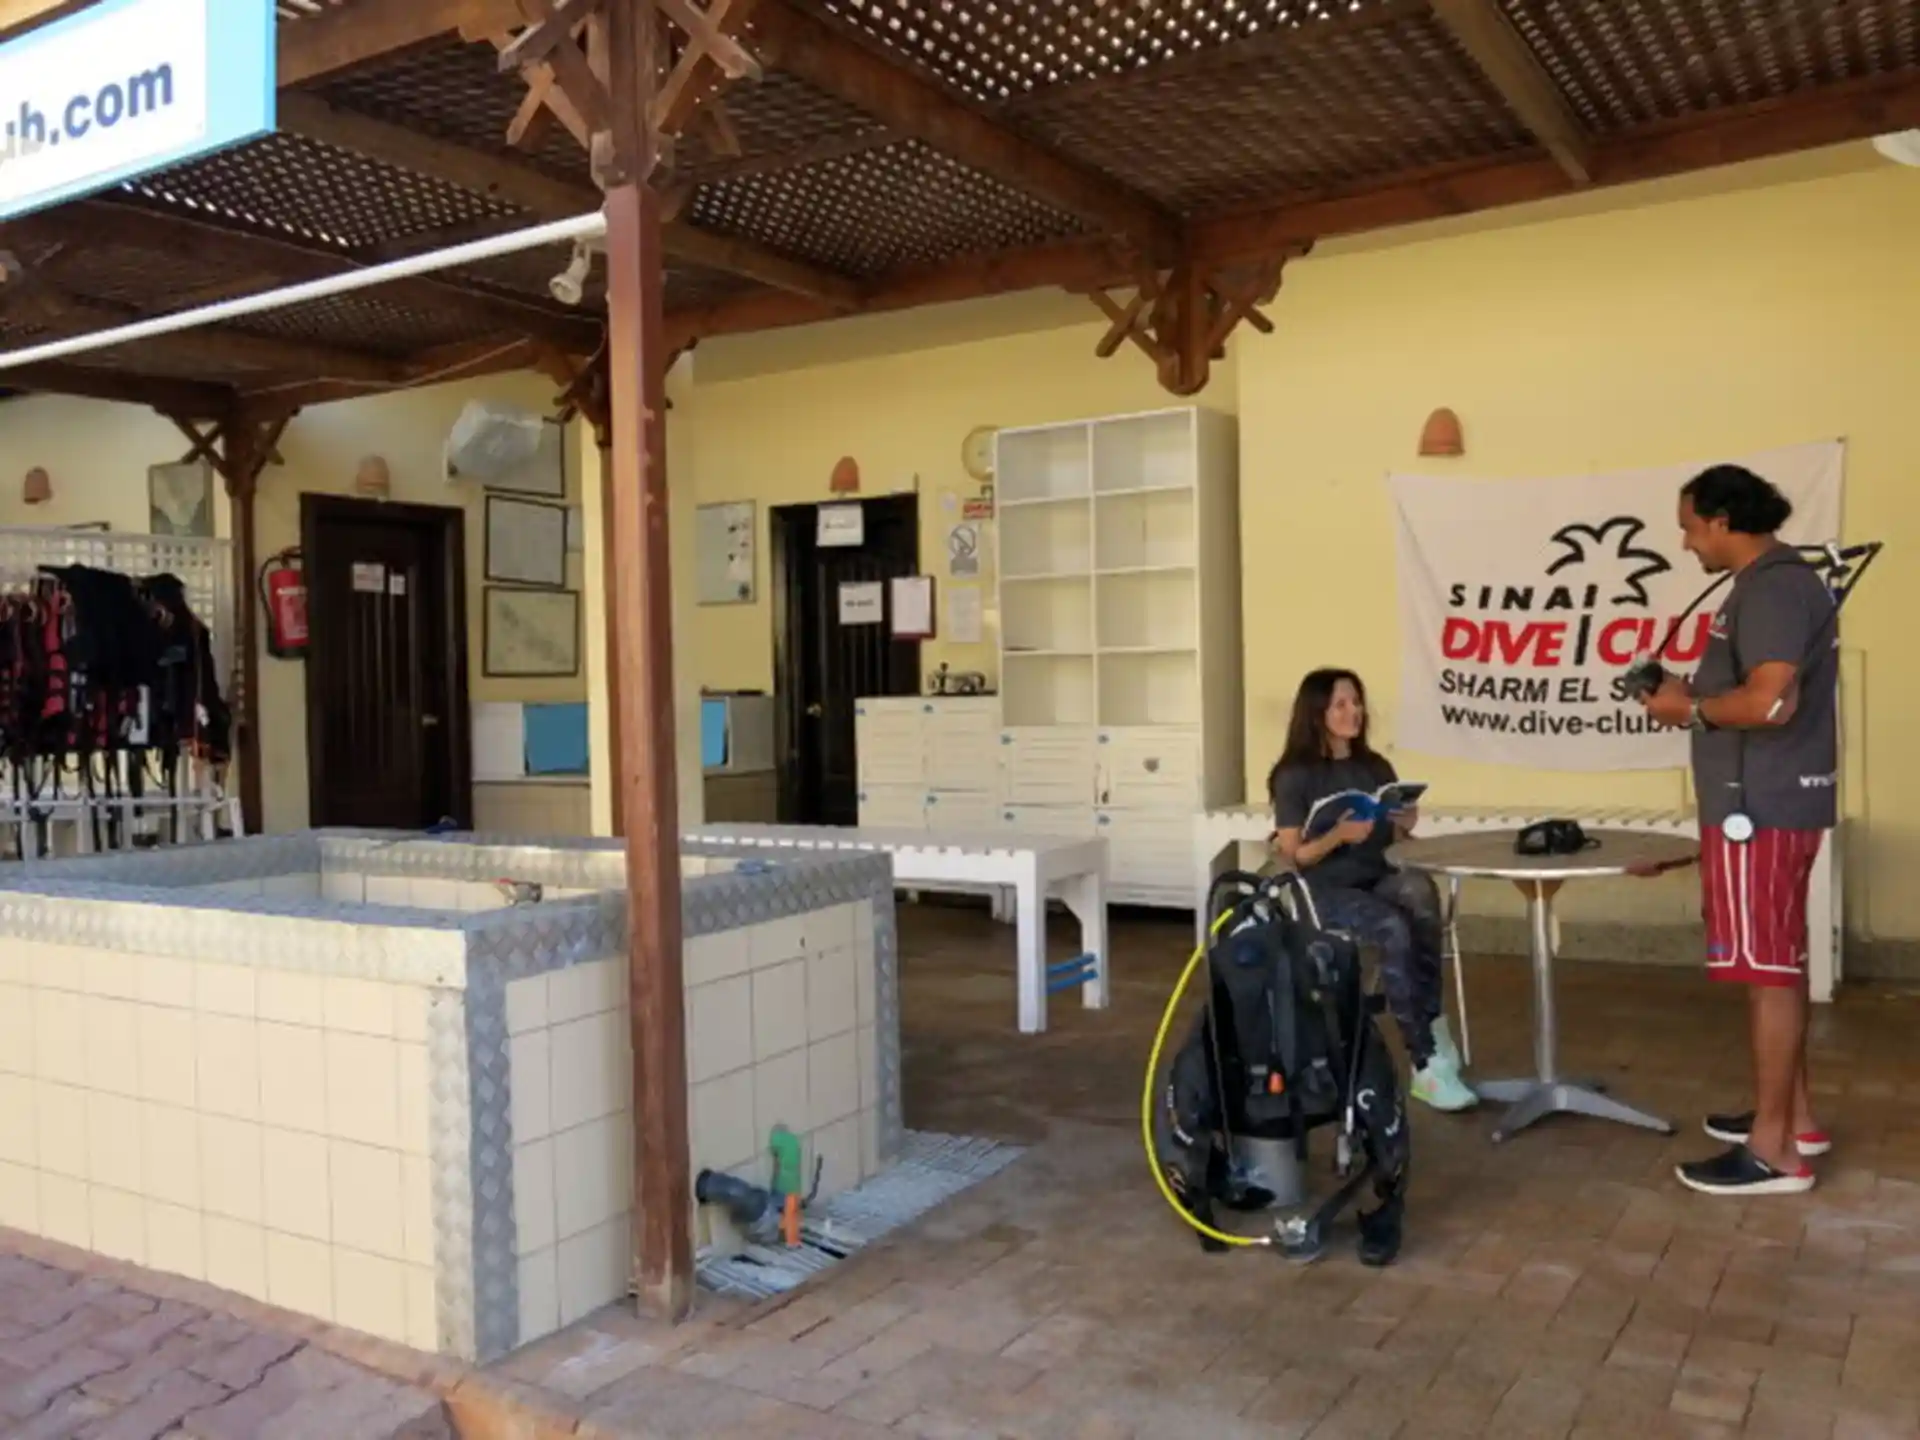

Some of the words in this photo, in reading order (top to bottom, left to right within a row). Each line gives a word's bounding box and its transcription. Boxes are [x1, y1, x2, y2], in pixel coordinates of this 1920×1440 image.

[1449, 583, 1598, 611] SINAI
[1442, 616, 1568, 667] DIVE
[1597, 611, 1714, 667] CLU
[1439, 668, 1550, 703] SHARM
[1559, 677, 1599, 703] EL
